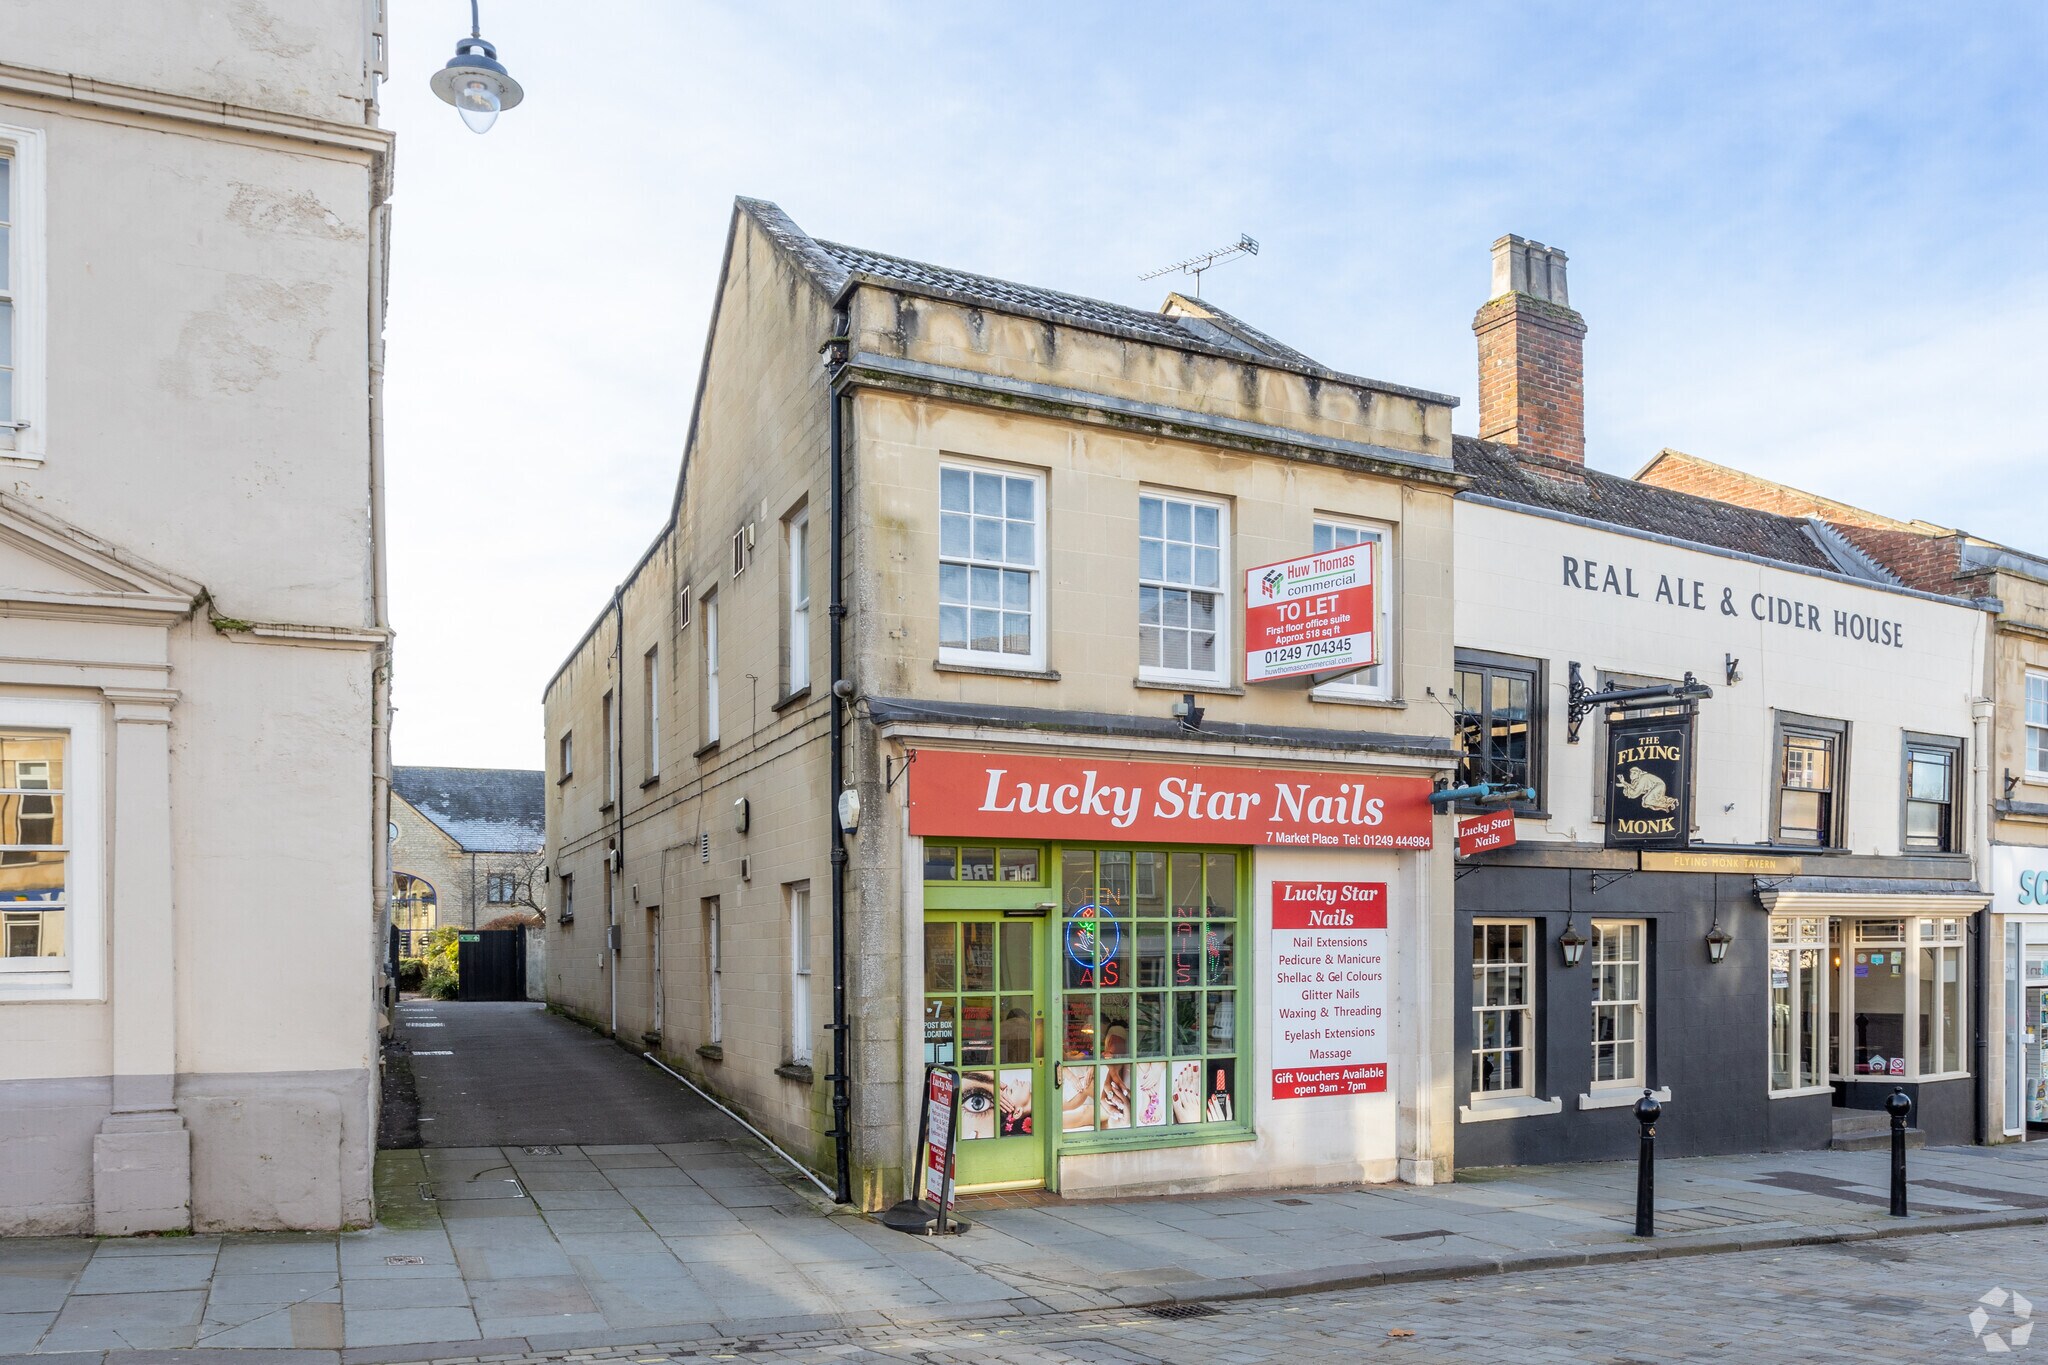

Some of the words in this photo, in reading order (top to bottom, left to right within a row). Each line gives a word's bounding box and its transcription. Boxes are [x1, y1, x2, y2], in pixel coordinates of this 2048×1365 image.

[1287, 564, 1310, 579] Huw
[1313, 554, 1355, 573] Thomas
[1287, 573, 1356, 596] commercial
[1276, 602, 1300, 622] TO
[1305, 594, 1339, 617] LET
[1562, 555, 1639, 598] REAL
[1655, 574, 1706, 611] ALE
[1720, 587, 1738, 617] &
[1751, 593, 1822, 633] CIDER
[1834, 609, 1904, 649] HOUSE
[1266, 626, 1284, 636] First
[1285, 623, 1304, 633] floor
[1306, 618, 1329, 629] office
[1330, 614, 1351, 625] suite
[1275, 634, 1304, 645] Approx
[1306, 630, 1320, 639] 518
[1322, 629, 1332, 639] sq
[1334, 625, 1341, 634] ft
[1265, 646, 1301, 664] 01249
[1306, 638, 1352, 657] 704345
[1265, 656, 1352, 676] huwthomascommercial.com
[1639, 736, 1660, 746] THE
[1617, 745, 1680, 765] FLYING
[978, 768, 1142, 828] Lucky
[1153, 776, 1261, 821] Star
[1268, 783, 1385, 826] Nails
[1461, 823, 1489, 837] Lucky
[1491, 819, 1513, 830] Star
[1618, 817, 1675, 834] MONK
[1266, 832, 1273, 843] 7
[1275, 832, 1310, 844] Market
[1312, 833, 1339, 845] Place
[1343, 834, 1361, 846] Tel:
[1363, 834, 1393, 846] 01249
[1395, 836, 1431, 848] 444984
[1475, 833, 1501, 848] Nails
[1674, 856, 1708, 867] FLYING
[1712, 858, 1739, 868] MONK
[1743, 860, 1776, 869] TAVERN
[1283, 884, 1337, 905] Lucky
[1341, 885, 1378, 901] Star
[1308, 909, 1354, 926] Nails
[1293, 937, 1313, 947] Nail
[1317, 937, 1368, 947] Extensions
[1279, 954, 1321, 965] Pedicure
[1325, 954, 1334, 965] &
[1337, 954, 1381, 964] Manicure
[1277, 972, 1312, 983] Shellac
[1316, 971, 1324, 982] &
[1328, 971, 1343, 982] Gel
[1346, 970, 1382, 981] Colours
[1301, 989, 1333, 1000] Glitter
[1336, 988, 1360, 999] Nails
[1279, 1007, 1317, 1020] Waxing
[1320, 1007, 1329, 1017] &
[1334, 1005, 1382, 1018] Threading
[940, 1021, 953, 1029] BOX
[924, 1030, 953, 1038] LOCATION
[1285, 1029, 1321, 1043] Eyelash
[1325, 1027, 1375, 1039] Extensions
[1309, 1049, 1352, 1060] Massage
[1275, 1072, 1293, 1084] Gift
[1296, 1070, 1339, 1082] Vouchers
[1342, 1067, 1384, 1079] Available
[1294, 1085, 1316, 1096] open
[1319, 1083, 1338, 1092] 9am
[1347, 1081, 1366, 1093] 7pm
